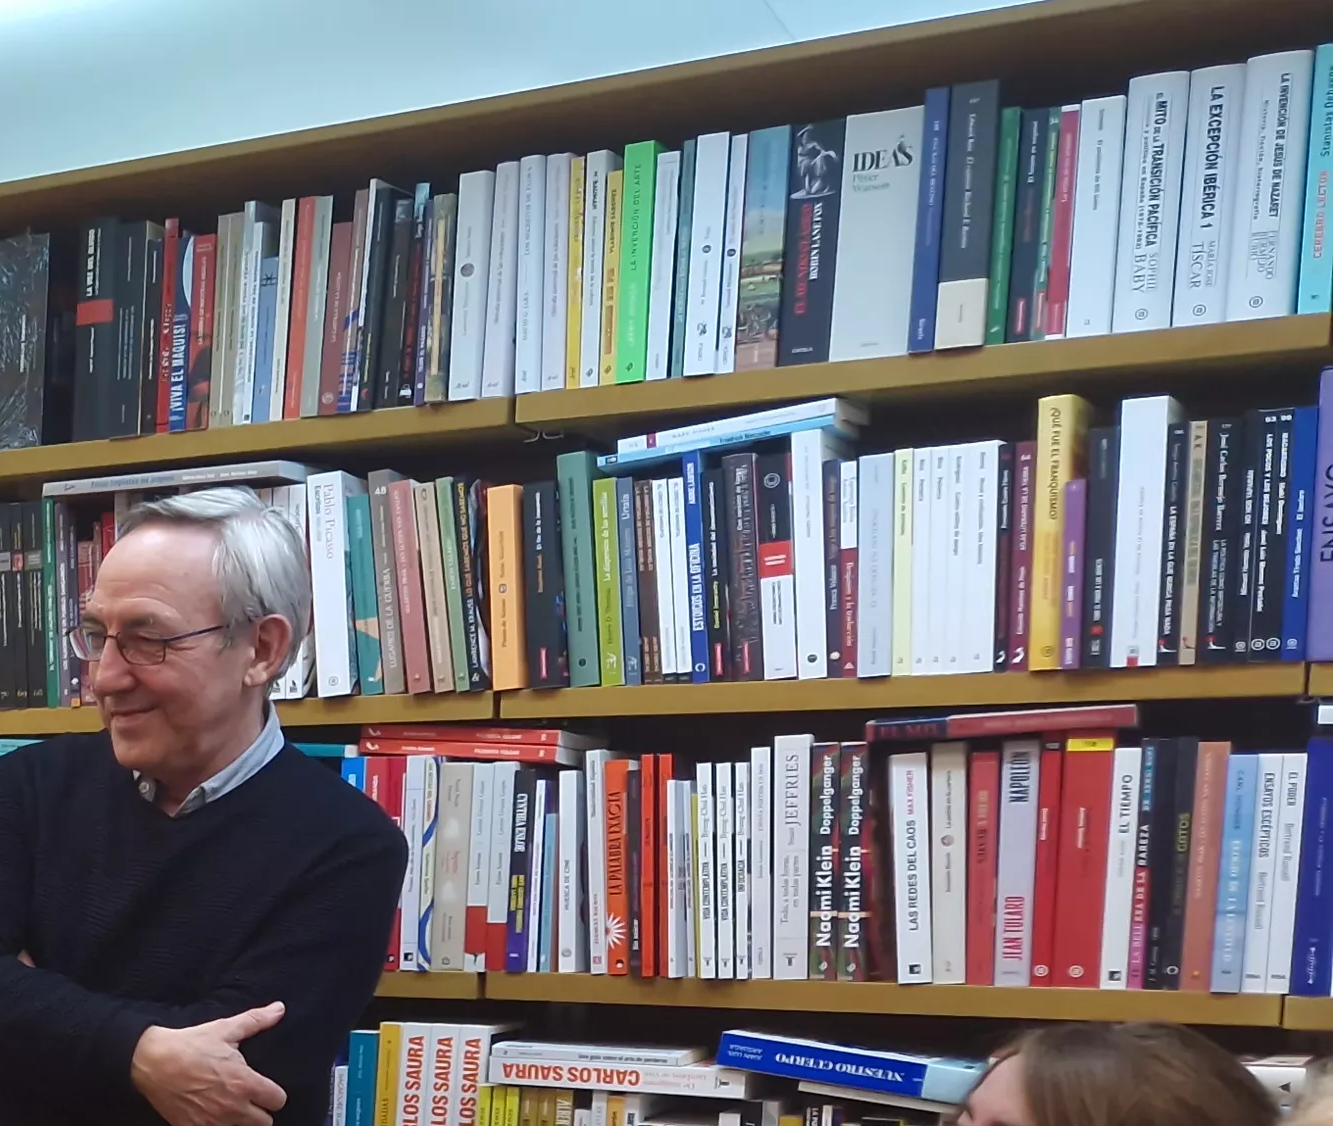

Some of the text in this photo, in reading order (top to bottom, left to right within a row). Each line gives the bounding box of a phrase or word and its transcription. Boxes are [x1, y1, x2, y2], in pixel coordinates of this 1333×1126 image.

[1154, 100, 1168, 125] MITO
[1211, 86, 1224, 101] LA
[1206, 104, 1224, 170] EXCEPCIÓN
[1269, 73, 1290, 218] LA INVENCIÓN DE JESÚS DE NAZARET
[1149, 143, 1164, 201] TRANSICIÓN
[1200, 173, 1221, 220] IBÉRICA
[630, 208, 640, 257] INVENCIÓN
[1144, 203, 1162, 248] PACÍFICA
[1132, 253, 1147, 293] BABY
[1189, 241, 1205, 290] TÍSCAR
[171, 324, 185, 411] ¡VIVA EL MAQUIS!
[1047, 407, 1064, 520] ¿QUÉ FUE EL FRANQUISMO?
[322, 484, 336, 559] Pablo Picasso
[690, 543, 701, 573] OFICINA
[383, 568, 393, 603] GUERRA
[692, 583, 702, 593] EN
[693, 595, 704, 630] ESTOICOS
[785, 754, 801, 826] JEFFRIES
[1008, 751, 1030, 803] NAPOLEÓN
[1262, 772, 1275, 807] ENSAYOS
[1286, 782, 1298, 806] PODER
[1288, 772, 1298, 781] EL
[516, 793, 528, 825] CYNTHIA
[700, 800, 709, 838] Byung-Chul
[1119, 774, 1133, 833] EL TIEMPO
[607, 792, 623, 895] LA PALABRA EXACTA
[816, 755, 834, 947] Naomi Klein Doppelganger
[844, 756, 864, 948] Naomi Klein Doppelganger
[906, 820, 916, 849] CAOS
[1177, 813, 1190, 852] GATOS
[1258, 809, 1272, 858] ESCÉPTICOS
[792, 856, 801, 877] partes
[907, 851, 917, 871] DEL
[701, 862, 710, 906] CONTEMPLATIVA
[719, 863, 729, 907] CONTEMPLATIVA
[907, 873, 917, 908] REDES
[702, 907, 711, 919] VIDA
[720, 908, 729, 920] VIDA
[780, 905, 789, 924] Todo,
[908, 911, 919, 931] LAS
[1002, 896, 1025, 960] JEAN TULARD
[406, 1036, 425, 1090] SAURA
[434, 1037, 453, 1091] SAURA
[462, 1038, 481, 1093] SAURA
[502, 1063, 640, 1086] CARLOS SAURA
[775, 1053, 905, 1082] NUESTRO CUERPO
